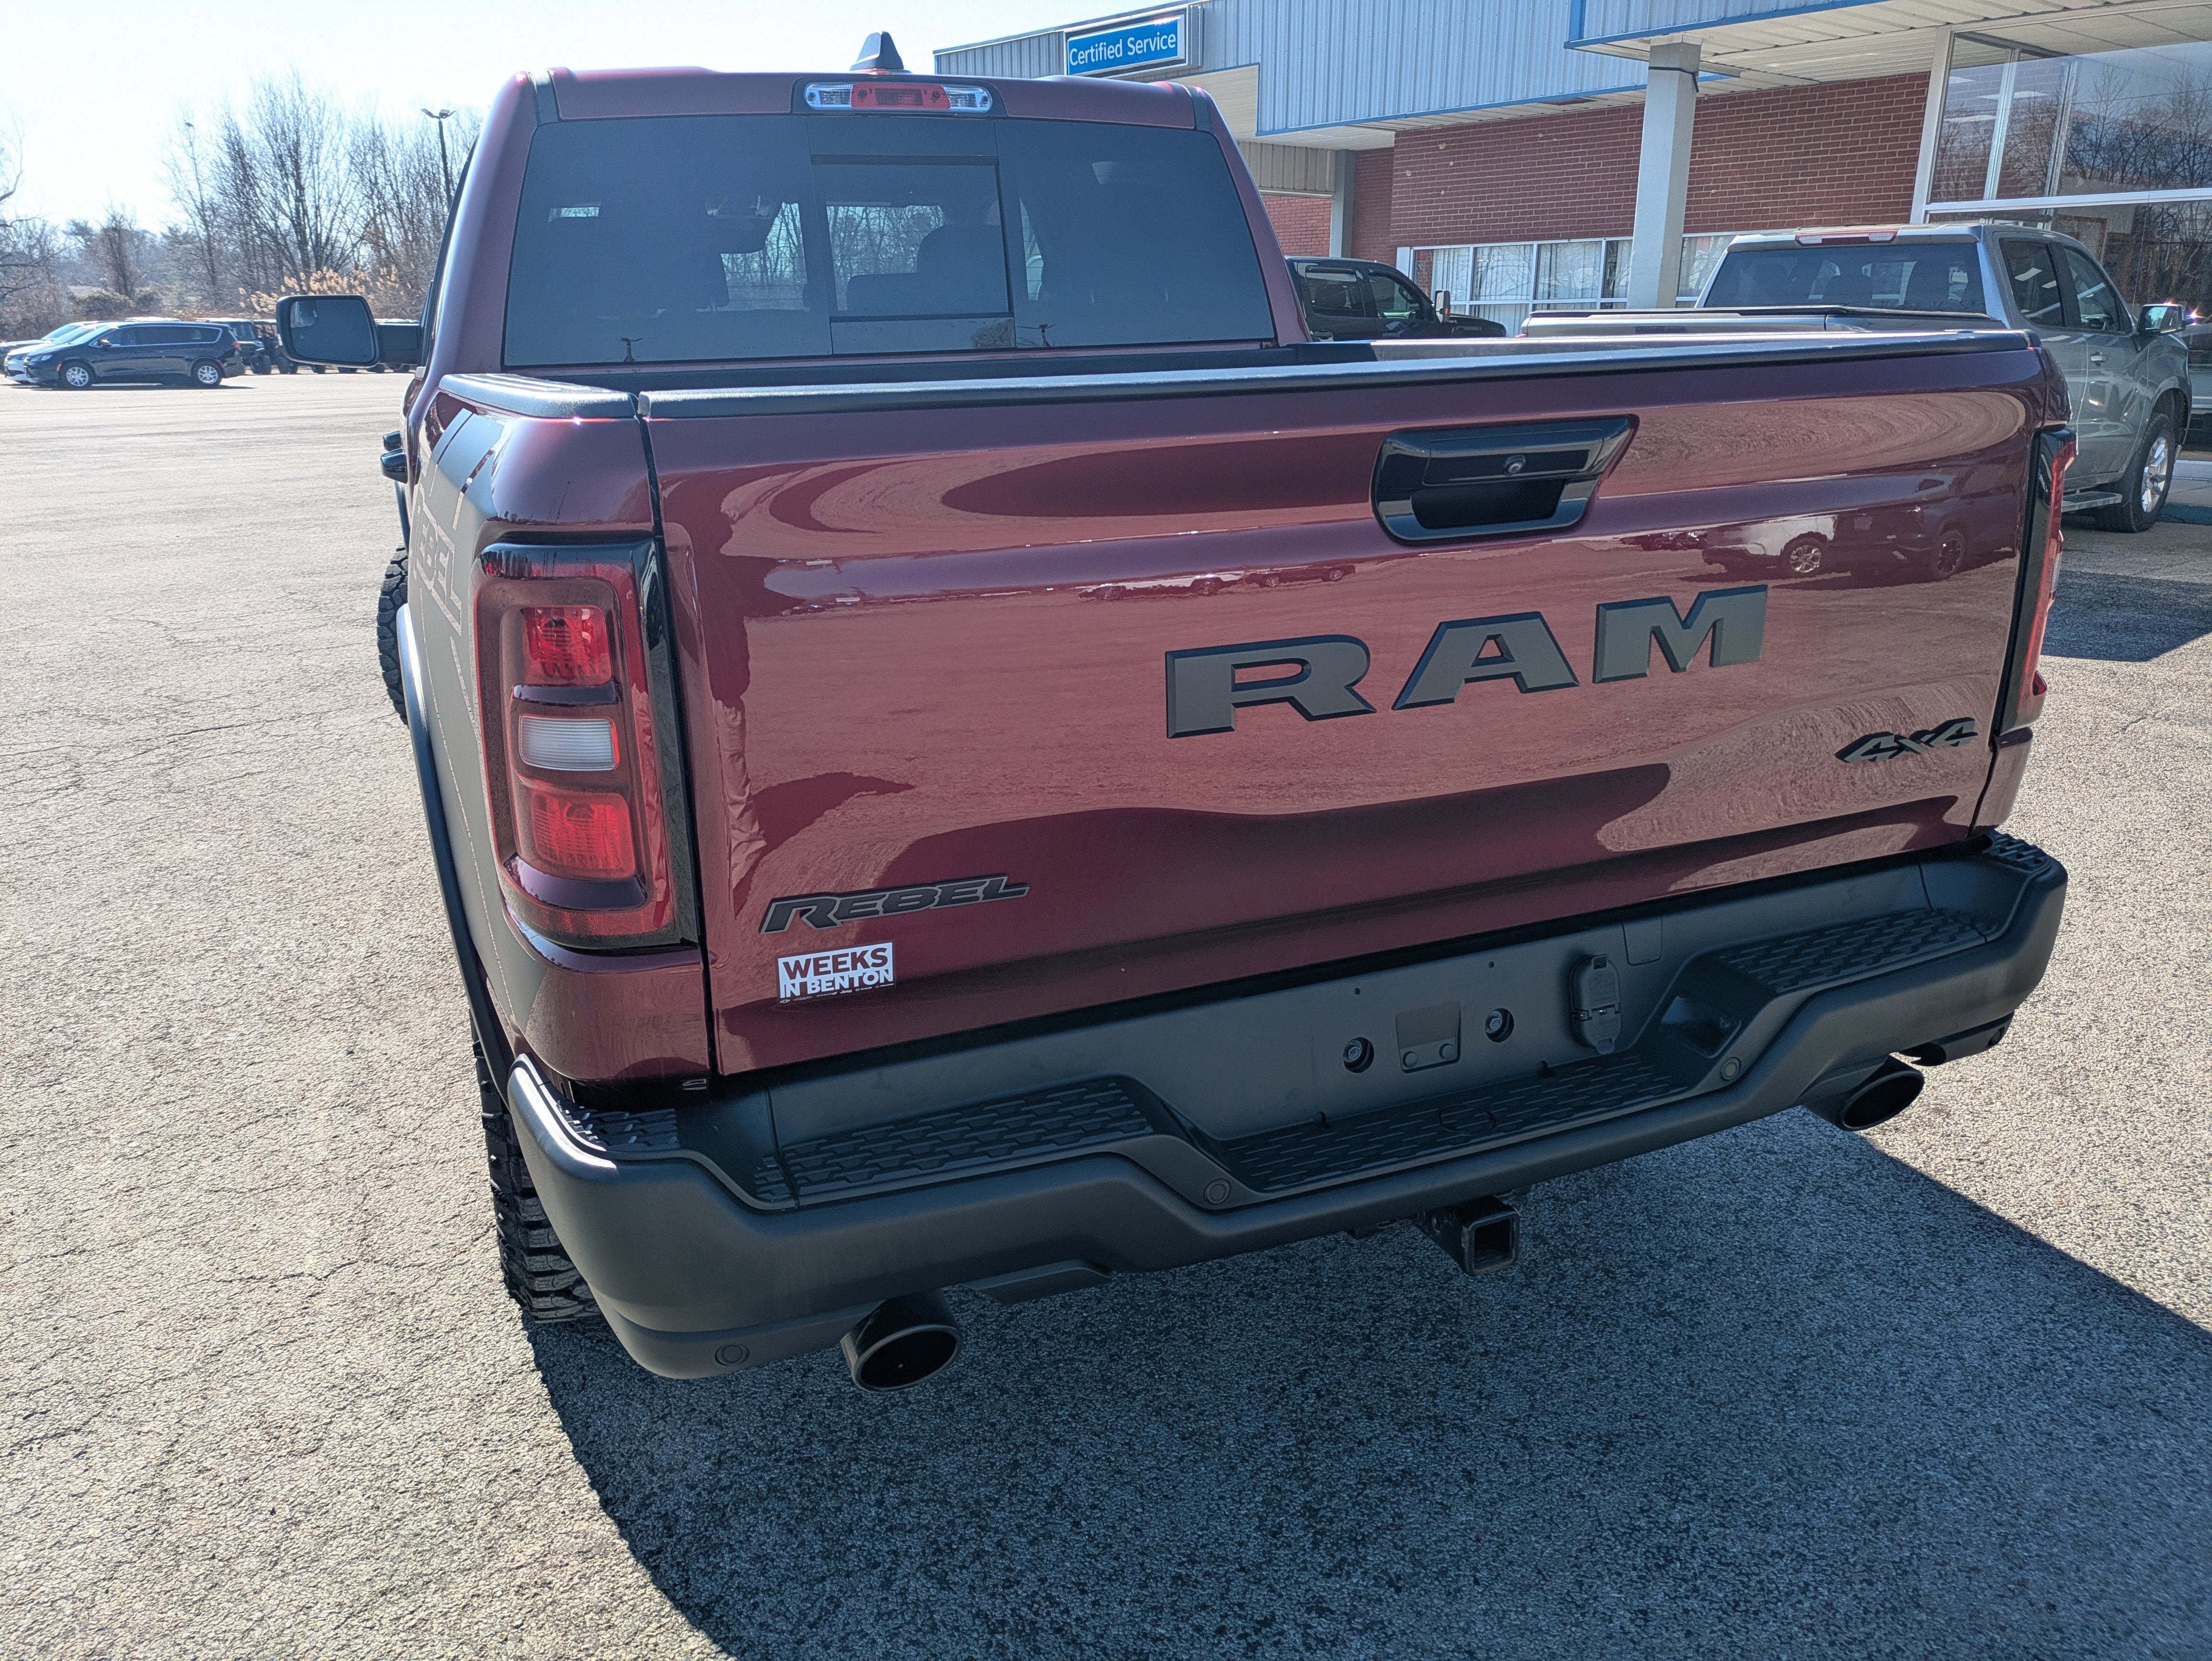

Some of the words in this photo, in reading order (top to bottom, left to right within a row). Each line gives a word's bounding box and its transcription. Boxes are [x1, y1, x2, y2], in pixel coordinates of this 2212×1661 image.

[1070, 39, 1123, 66] Certified
[1128, 32, 1176, 55] Service
[1165, 584, 1769, 739] RAM
[759, 874, 1030, 935] REBEL
[782, 947, 888, 980] WEEKS
[780, 981, 800, 998] IN
[807, 969, 894, 995] BENTON
